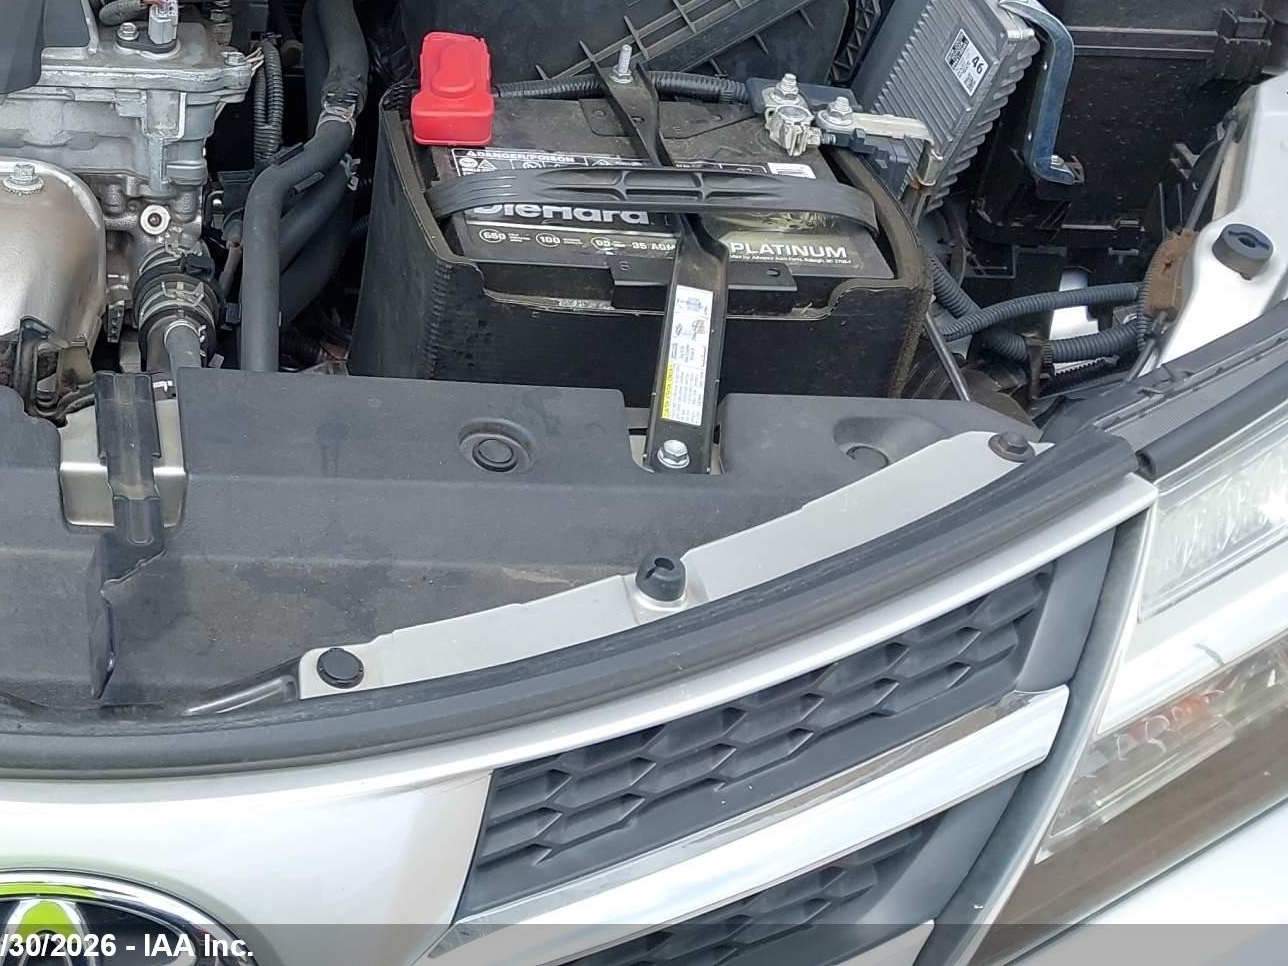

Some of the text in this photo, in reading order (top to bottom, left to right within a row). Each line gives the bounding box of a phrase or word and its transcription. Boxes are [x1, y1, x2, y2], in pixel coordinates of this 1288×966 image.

[972, 56, 984, 75] 46
[483, 231, 507, 240] 650
[539, 236, 561, 244] 100
[730, 242, 847, 259] PLATINUM
